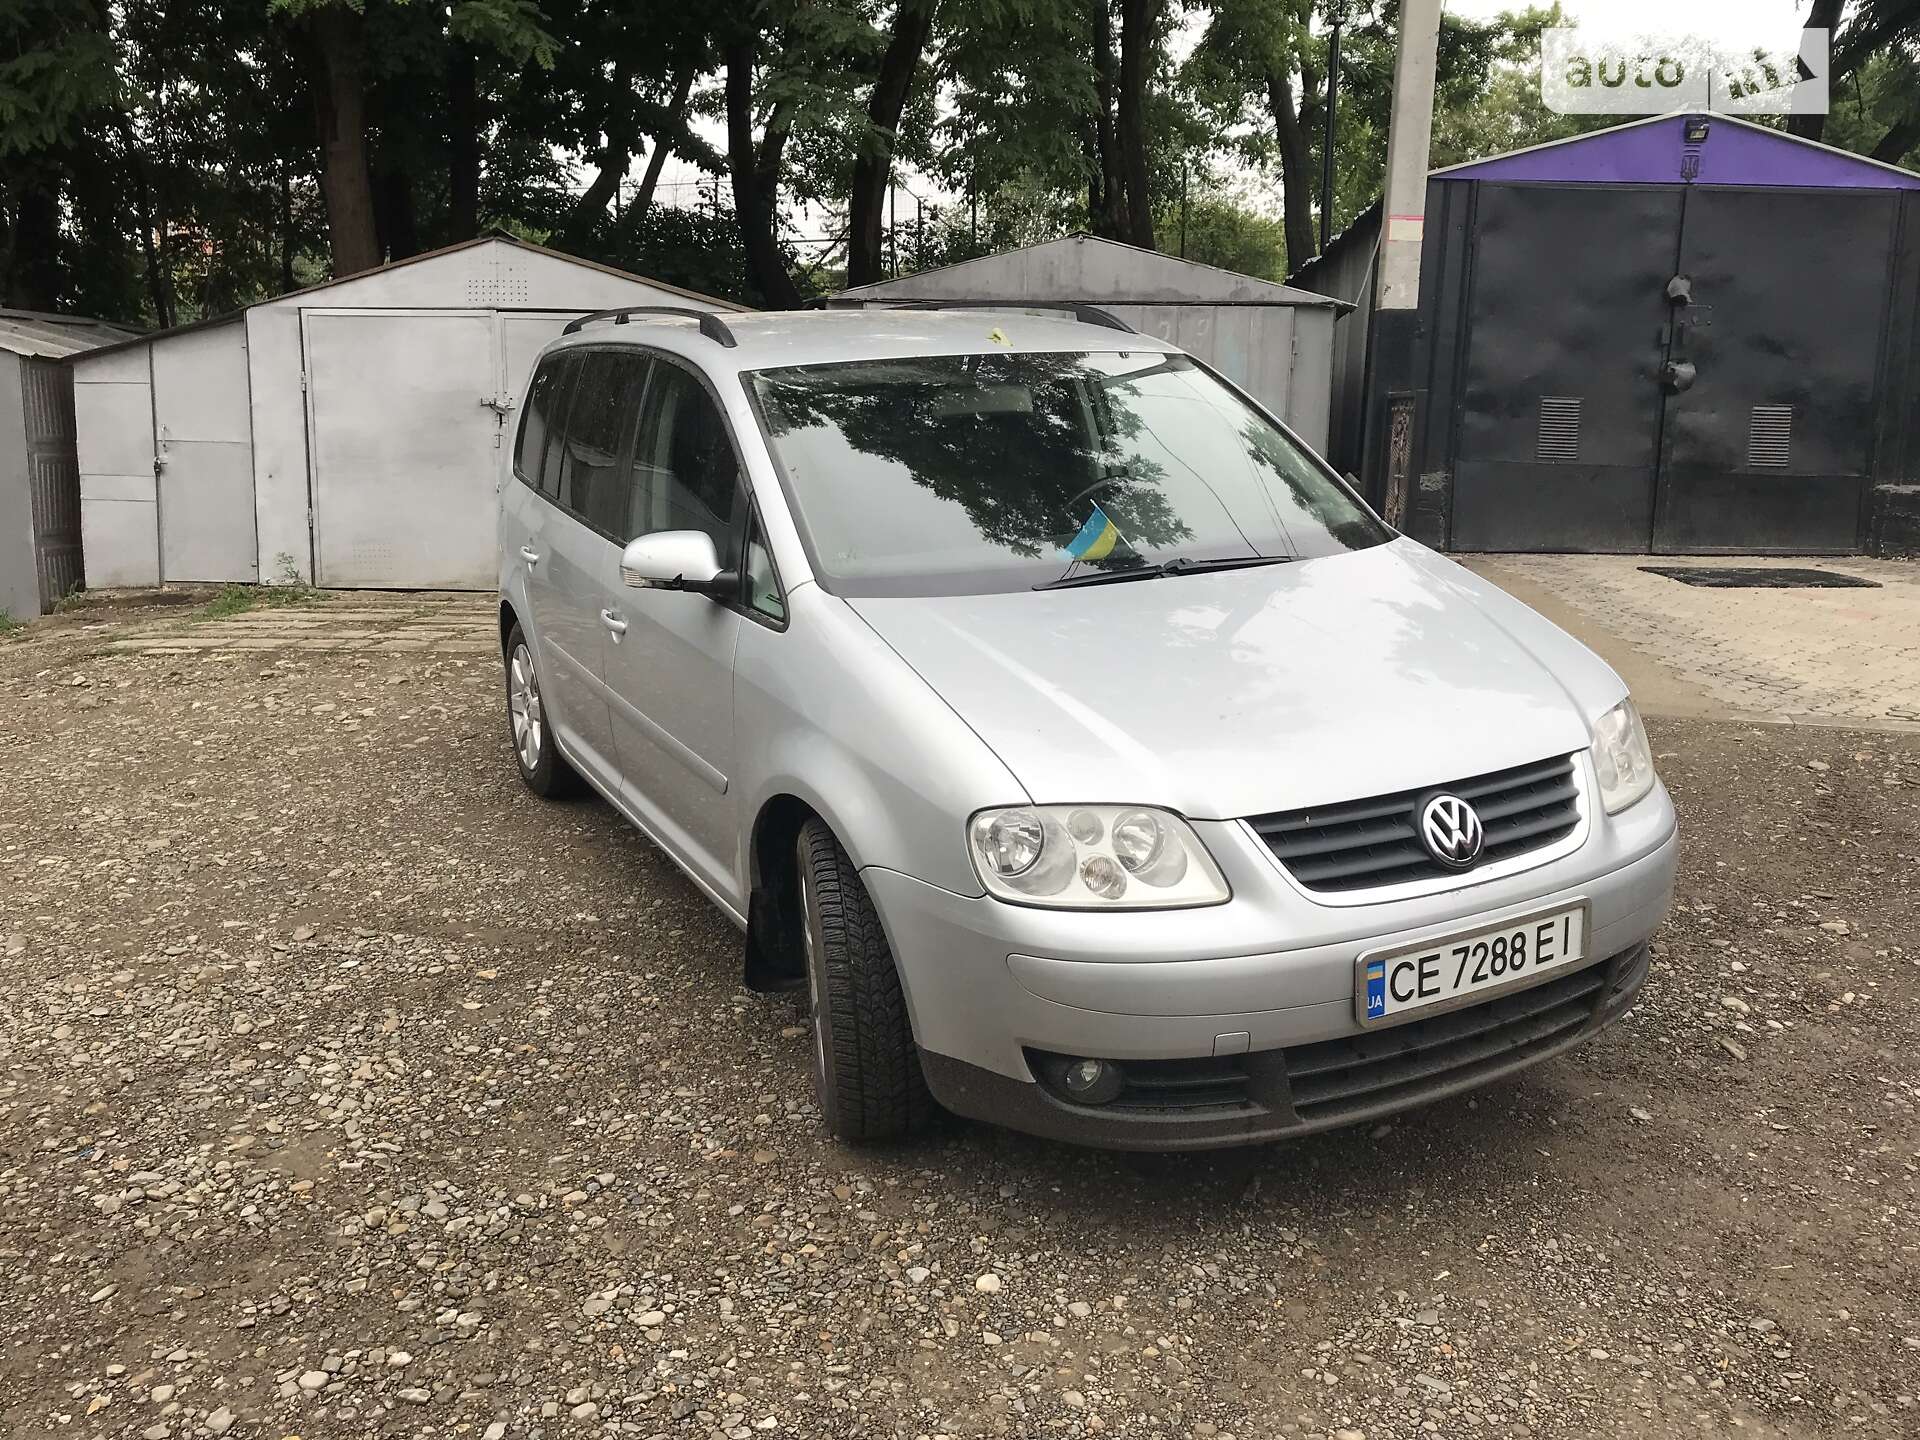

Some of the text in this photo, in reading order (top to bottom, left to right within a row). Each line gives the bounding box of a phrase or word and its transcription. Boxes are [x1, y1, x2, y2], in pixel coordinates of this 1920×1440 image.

[1423, 796, 1482, 861] VW
[1390, 916, 1570, 1002] CE 7288 EI
[1367, 999, 1383, 1009] UA
